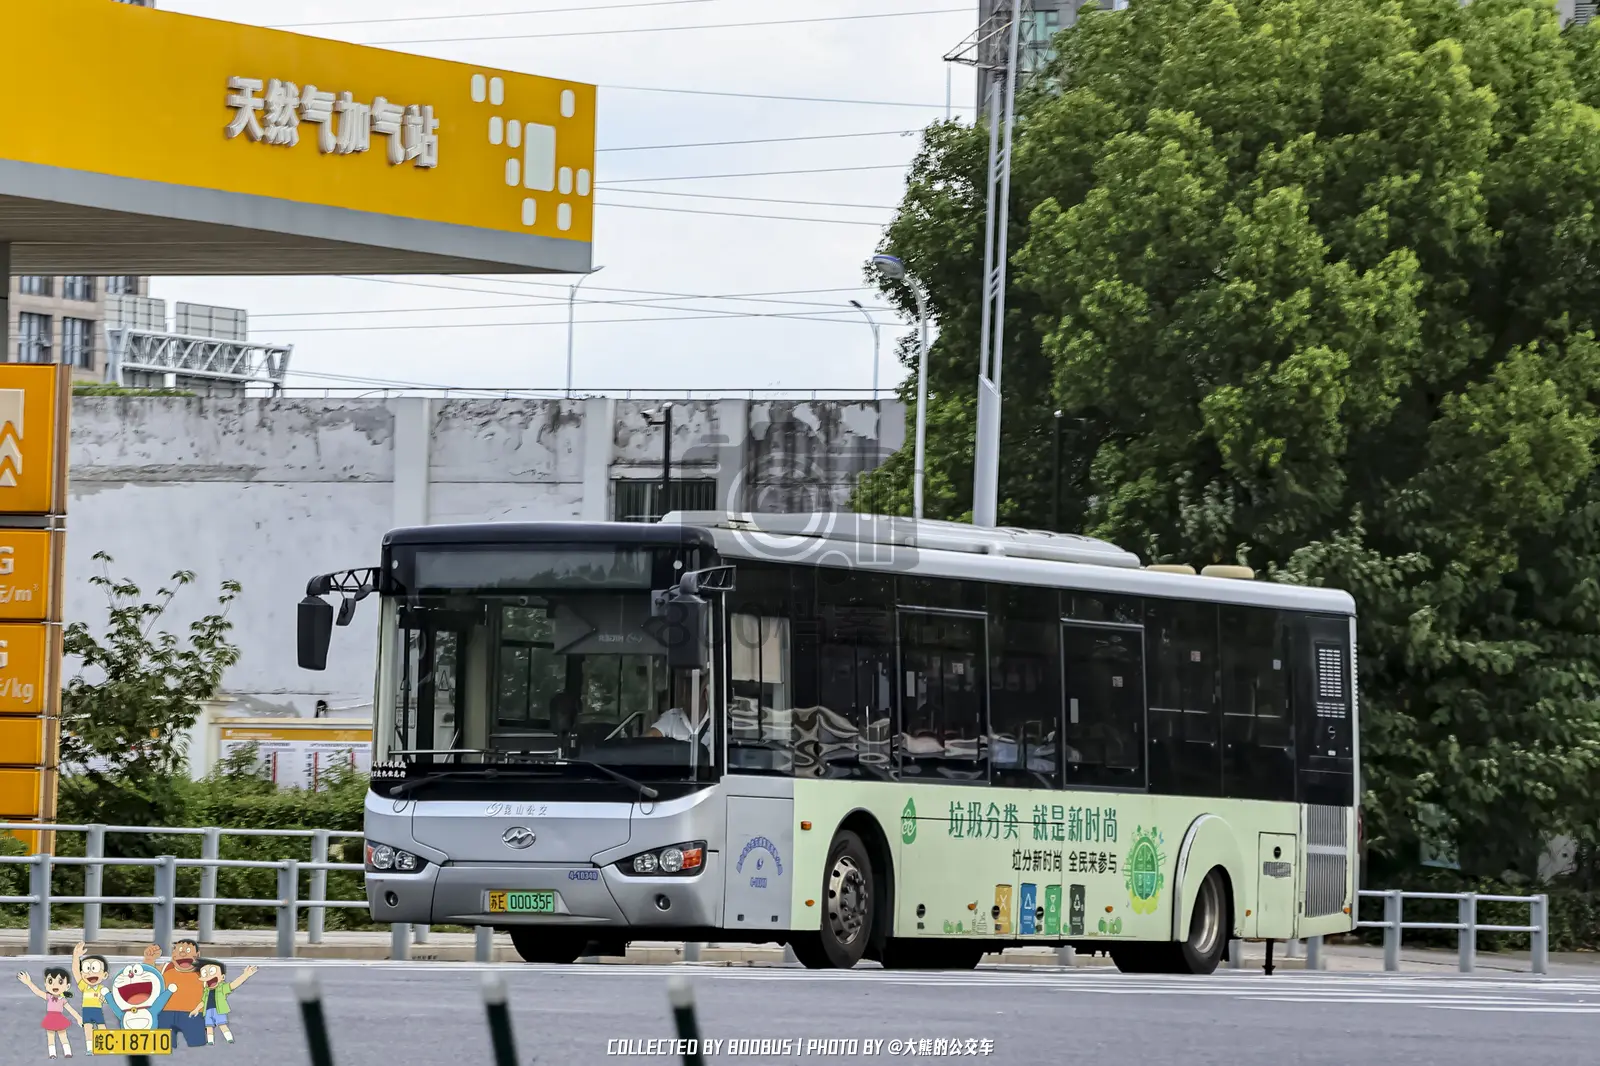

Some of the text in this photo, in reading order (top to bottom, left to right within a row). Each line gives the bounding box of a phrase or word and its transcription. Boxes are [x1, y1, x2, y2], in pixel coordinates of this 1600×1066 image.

[224, 75, 440, 169] 天然气加气站
[504, 804, 547, 816] 昆山公交
[948, 801, 1118, 843] 垃圾分类 就是新时尚
[1012, 849, 1117, 874] 垃分新时尚 全民来参与
